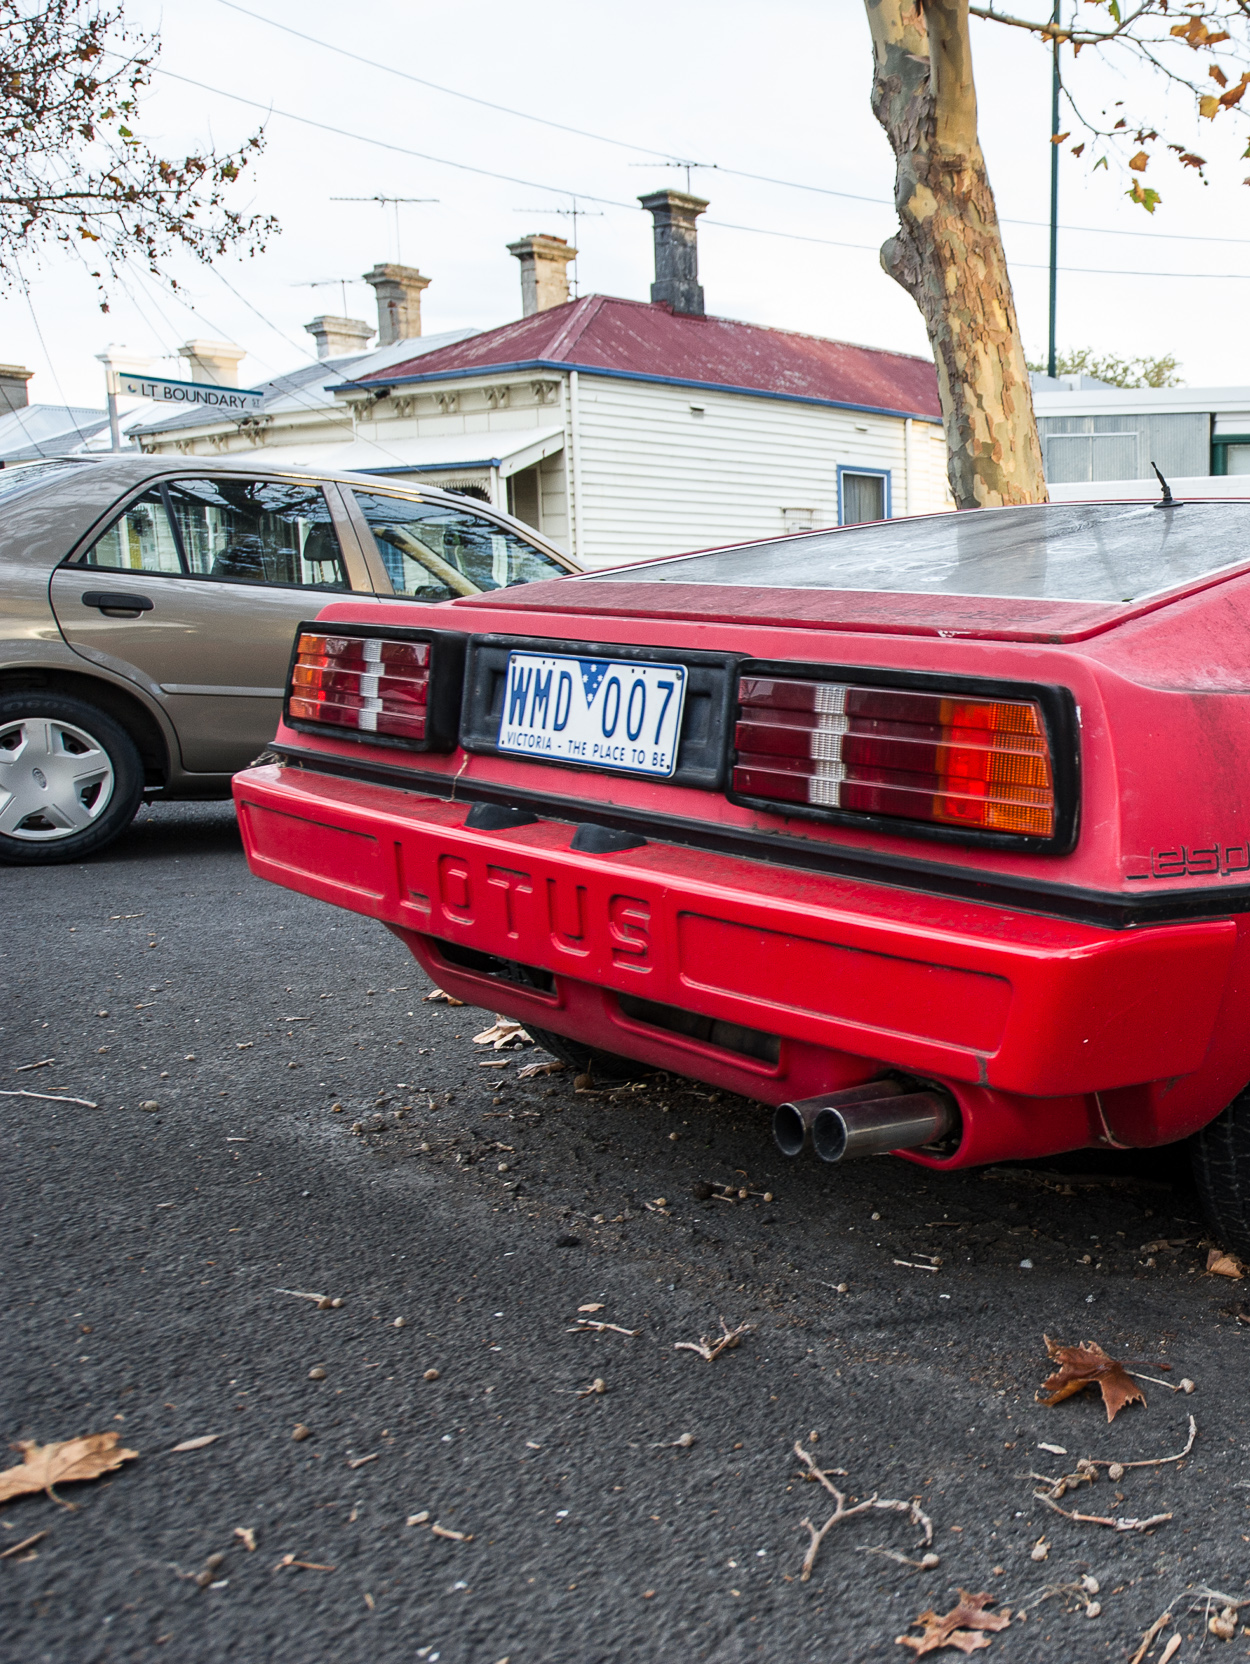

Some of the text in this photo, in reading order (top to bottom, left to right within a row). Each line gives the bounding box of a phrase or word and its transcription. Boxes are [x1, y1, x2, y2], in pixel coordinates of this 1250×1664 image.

[141, 383, 158, 397] LT
[163, 386, 247, 409] BOUNDARY
[509, 665, 675, 746] WMD 007
[507, 731, 552, 750] VICTORIA
[568, 739, 586, 756] THE
[593, 743, 625, 762] PLACE
[632, 749, 645, 765] TO
[652, 752, 666, 768] BE
[394, 841, 653, 973] LOTUS
